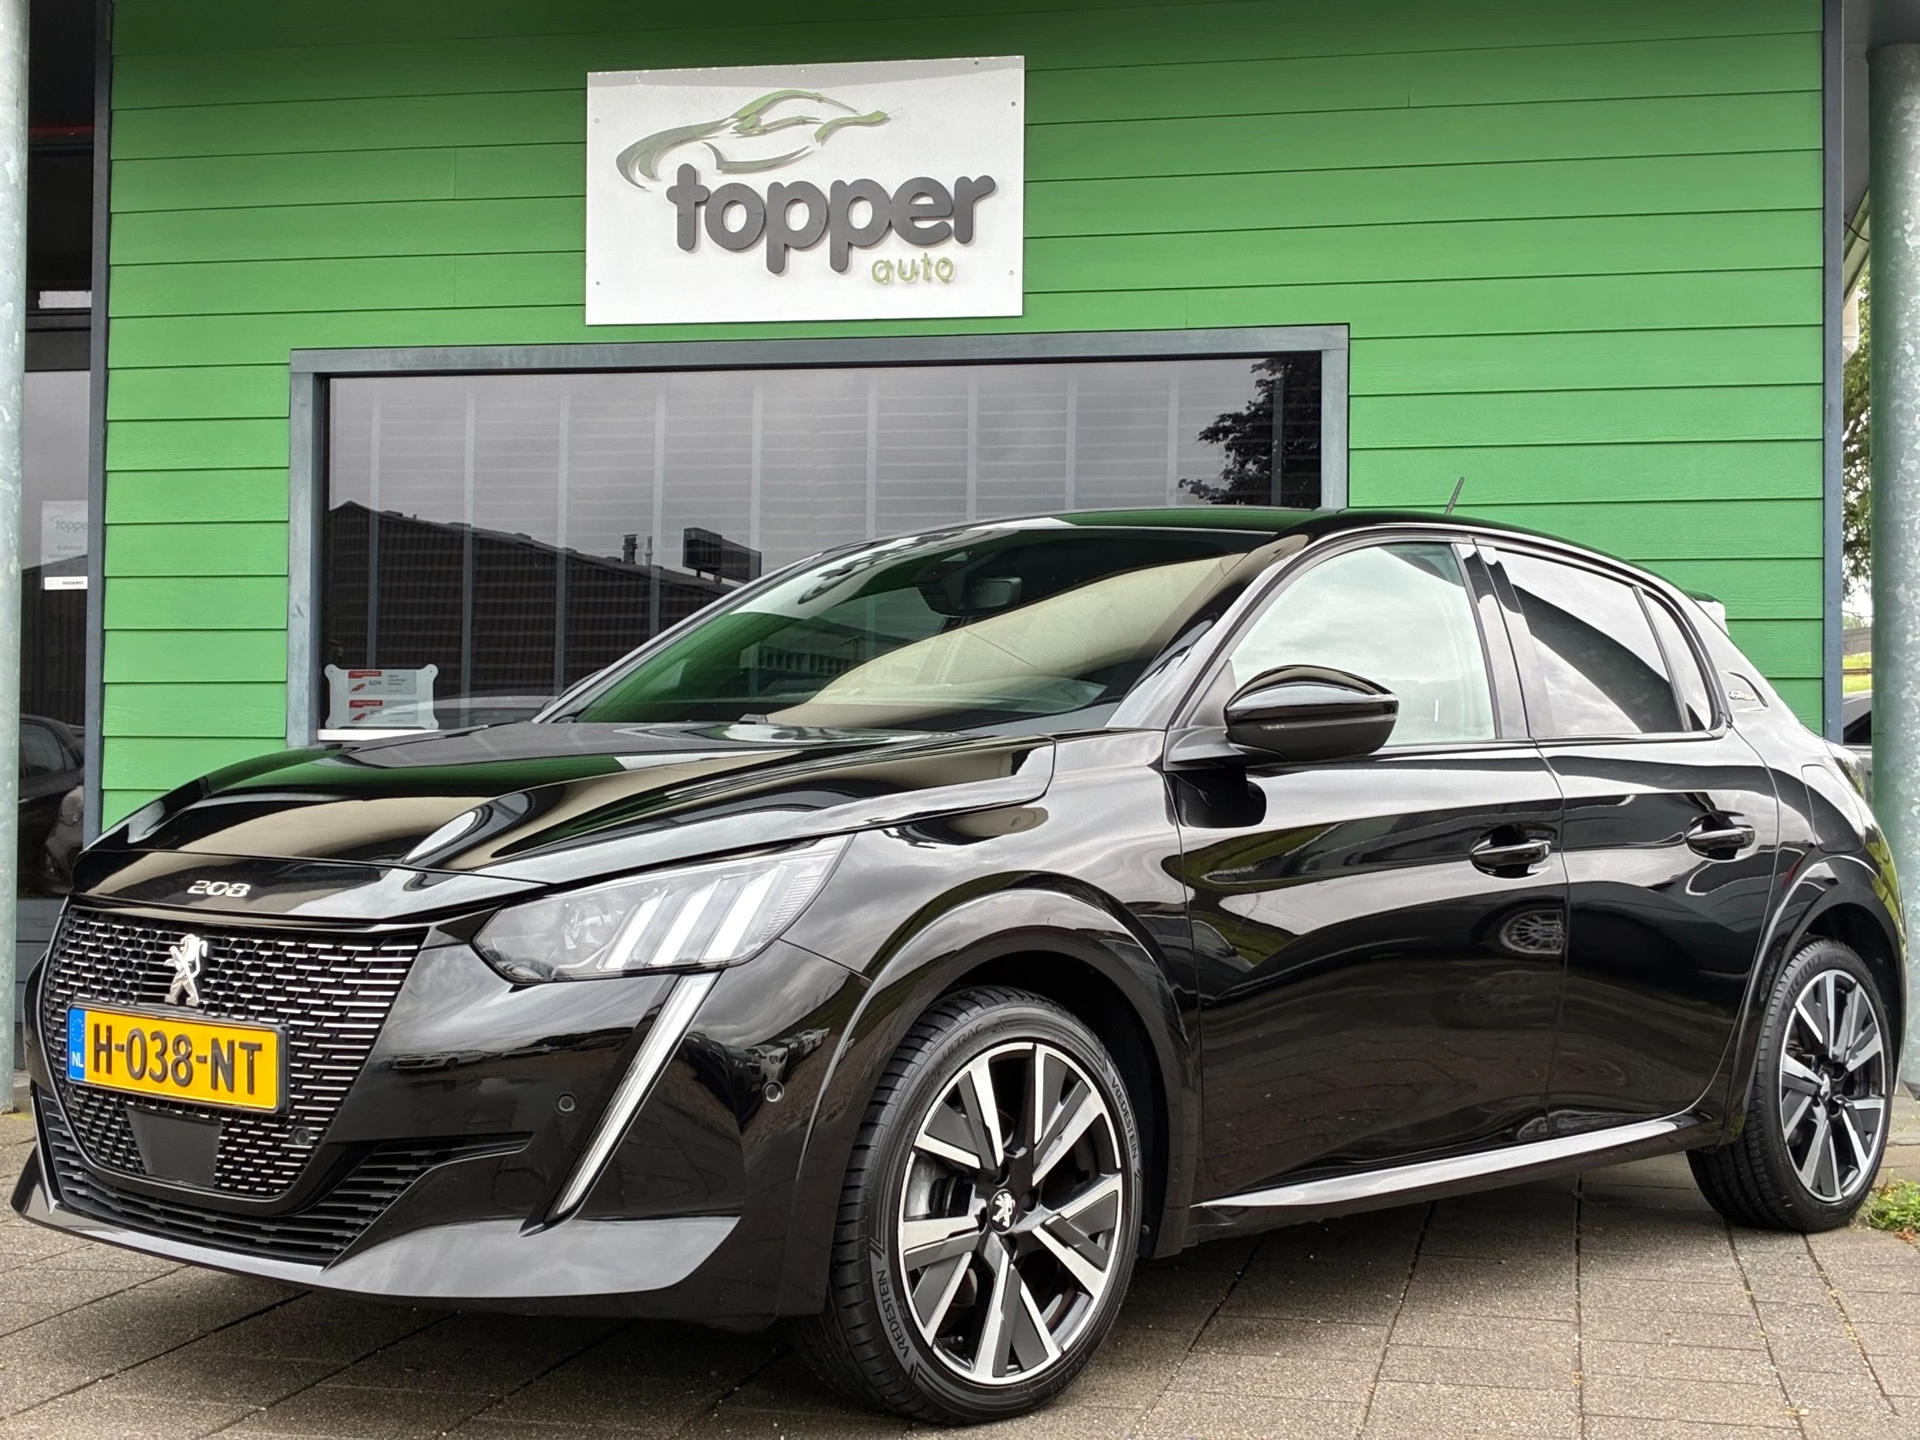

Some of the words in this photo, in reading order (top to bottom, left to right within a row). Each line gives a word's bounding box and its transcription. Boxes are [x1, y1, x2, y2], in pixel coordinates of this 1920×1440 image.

[667, 163, 997, 274] topper
[872, 252, 955, 283] auto
[187, 880, 251, 898] 208
[71, 1051, 84, 1068] NL
[93, 1023, 263, 1095] H-038-NT
[1111, 1076, 1139, 1160] VREDESTEIN
[876, 1270, 910, 1359] VREDESTEIN
